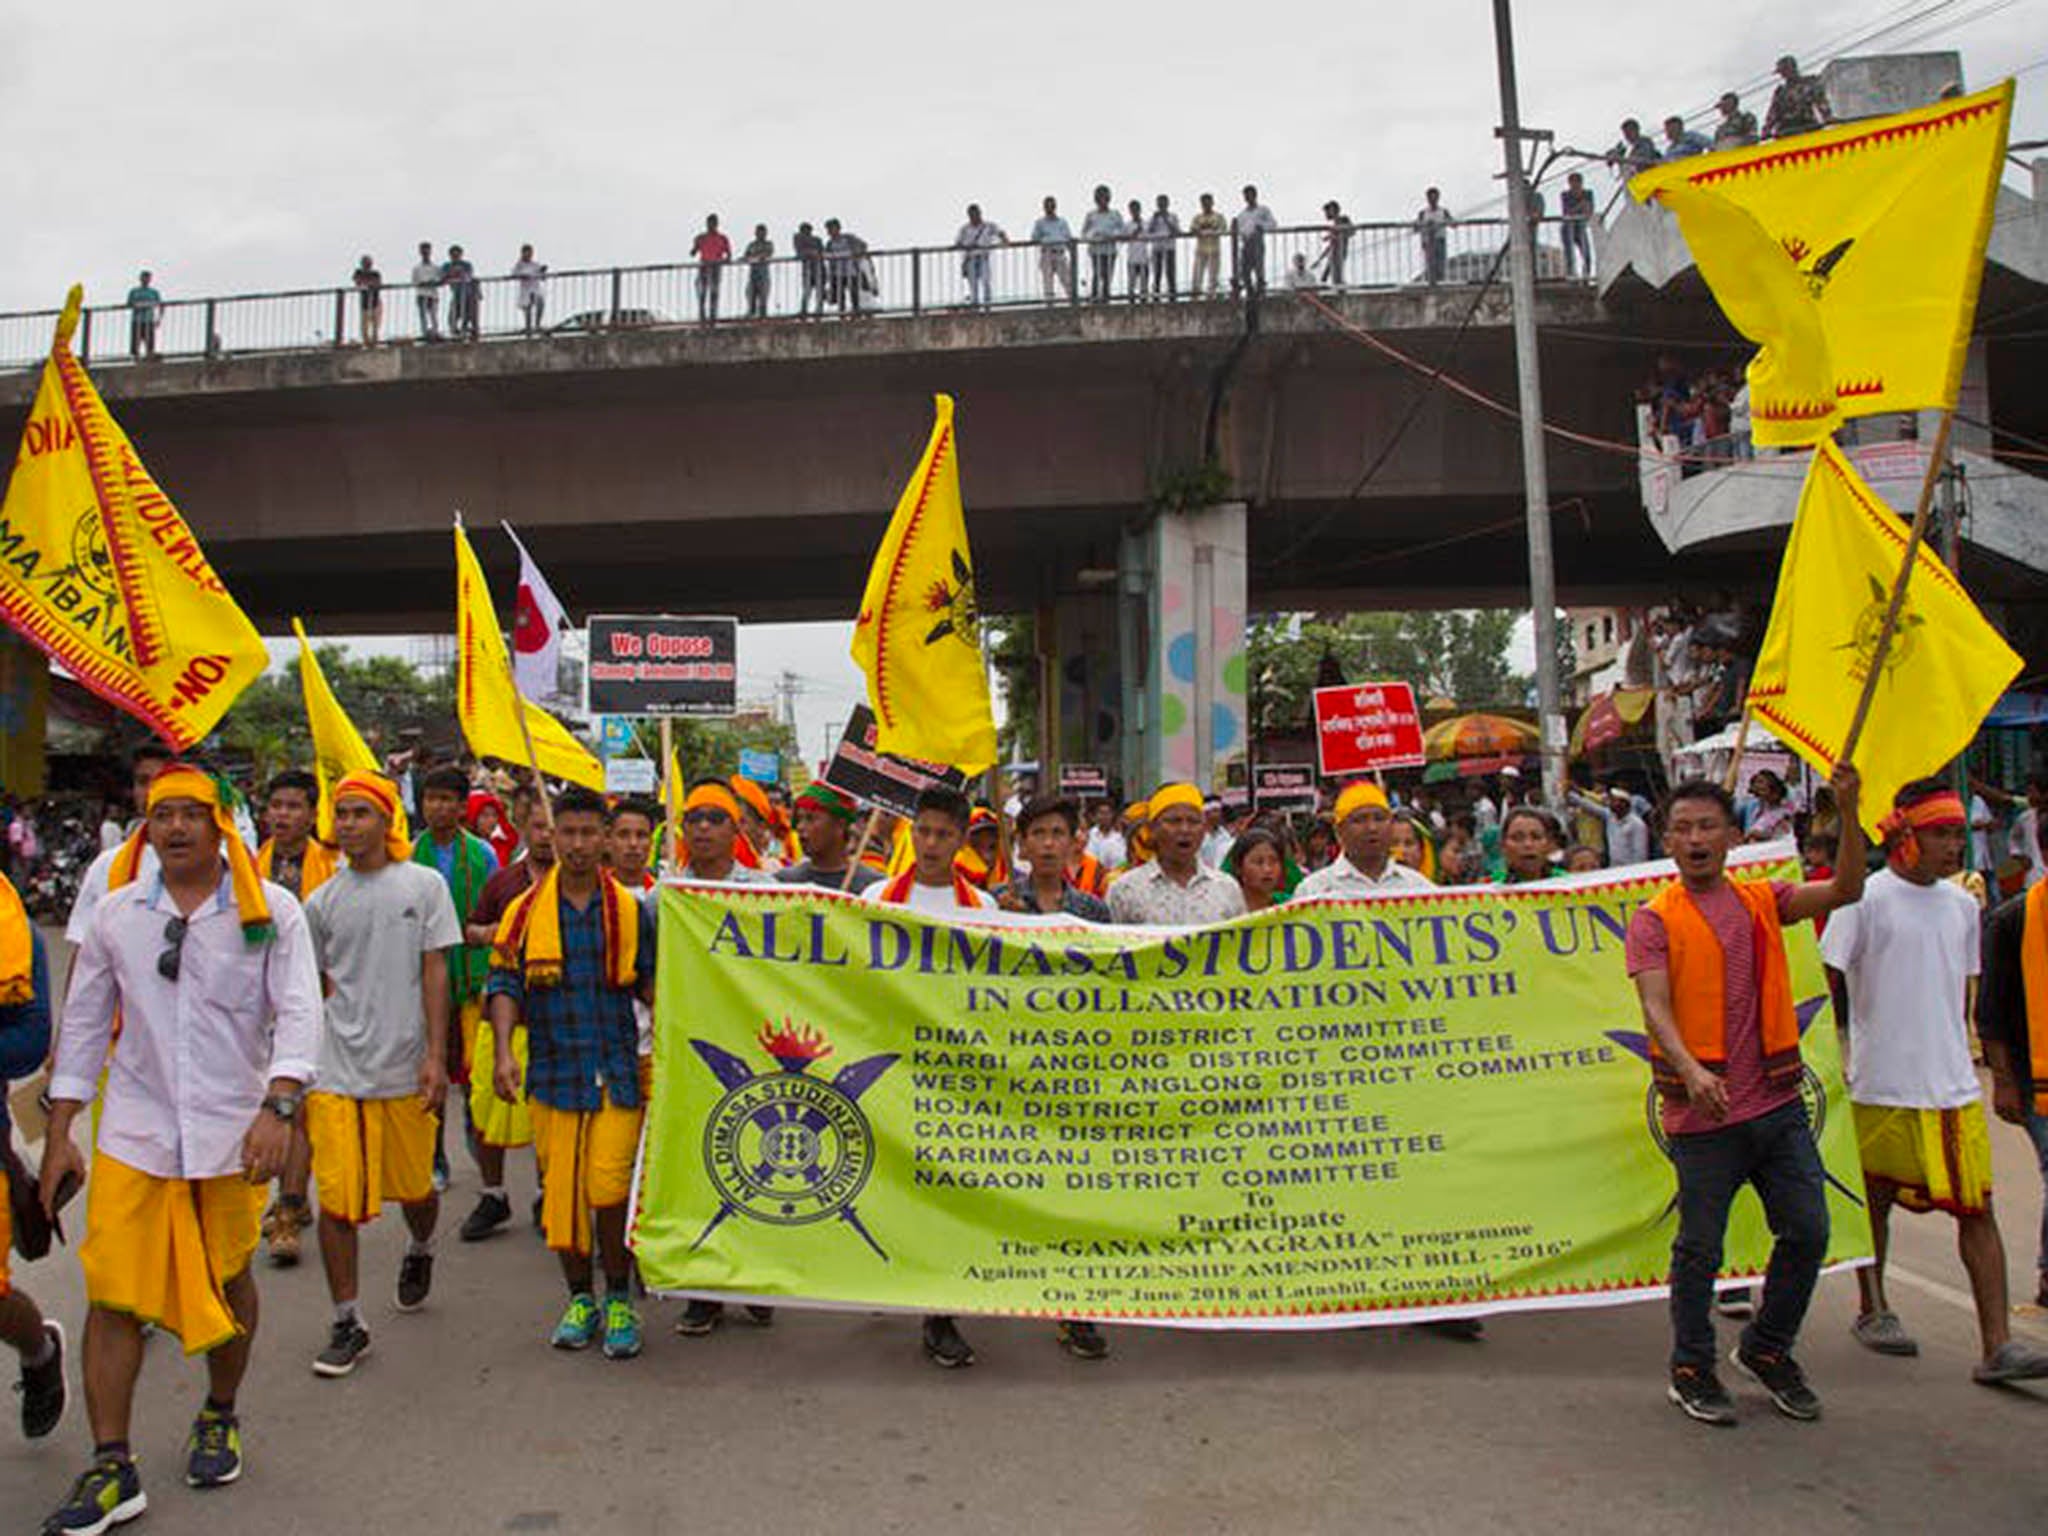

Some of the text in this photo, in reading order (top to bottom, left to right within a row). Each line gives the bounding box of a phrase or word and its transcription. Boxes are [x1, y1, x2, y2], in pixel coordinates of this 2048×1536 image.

[611, 632, 714, 659] We Oppose
[708, 901, 1628, 982] ALL DIMASA STUDENTS' UN
[967, 970, 1518, 1014] IN COLLABORATION WITH
[914, 1018, 1447, 1047] DIMA HASAO DISTRICT COMMITTEE
[914, 1035, 1514, 1071] KARBI ANGLONG DISTRICT COMMITTEE
[912, 1047, 1615, 1095] WEST KARBI ANGLONG DISTRICT COMMITTEE
[914, 1095, 1350, 1118] HOJAI DISTRICT COMMITTEE
[914, 1115, 1389, 1142] CACHAR DISTRICT COMMITTEE
[914, 1134, 1445, 1165] KARIMGANJ DISTRICT COMMITTEE
[914, 1162, 1398, 1190] NAGAON DISTRICT COMMITTEE
[1242, 1192, 1274, 1209] To
[1179, 1211, 1346, 1233] Participate
[998, 1240, 1039, 1256] The
[1402, 1224, 1533, 1248] programme
[964, 1266, 1047, 1282] Against
[1244, 1253, 1417, 1278] AMENDMENT
[1424, 1249, 1486, 1268] BILL
[1042, 1289, 1077, 1300] On
[1130, 1287, 1181, 1301] June
[1191, 1287, 1240, 1301] 2018
[1246, 1286, 1268, 1300] at
